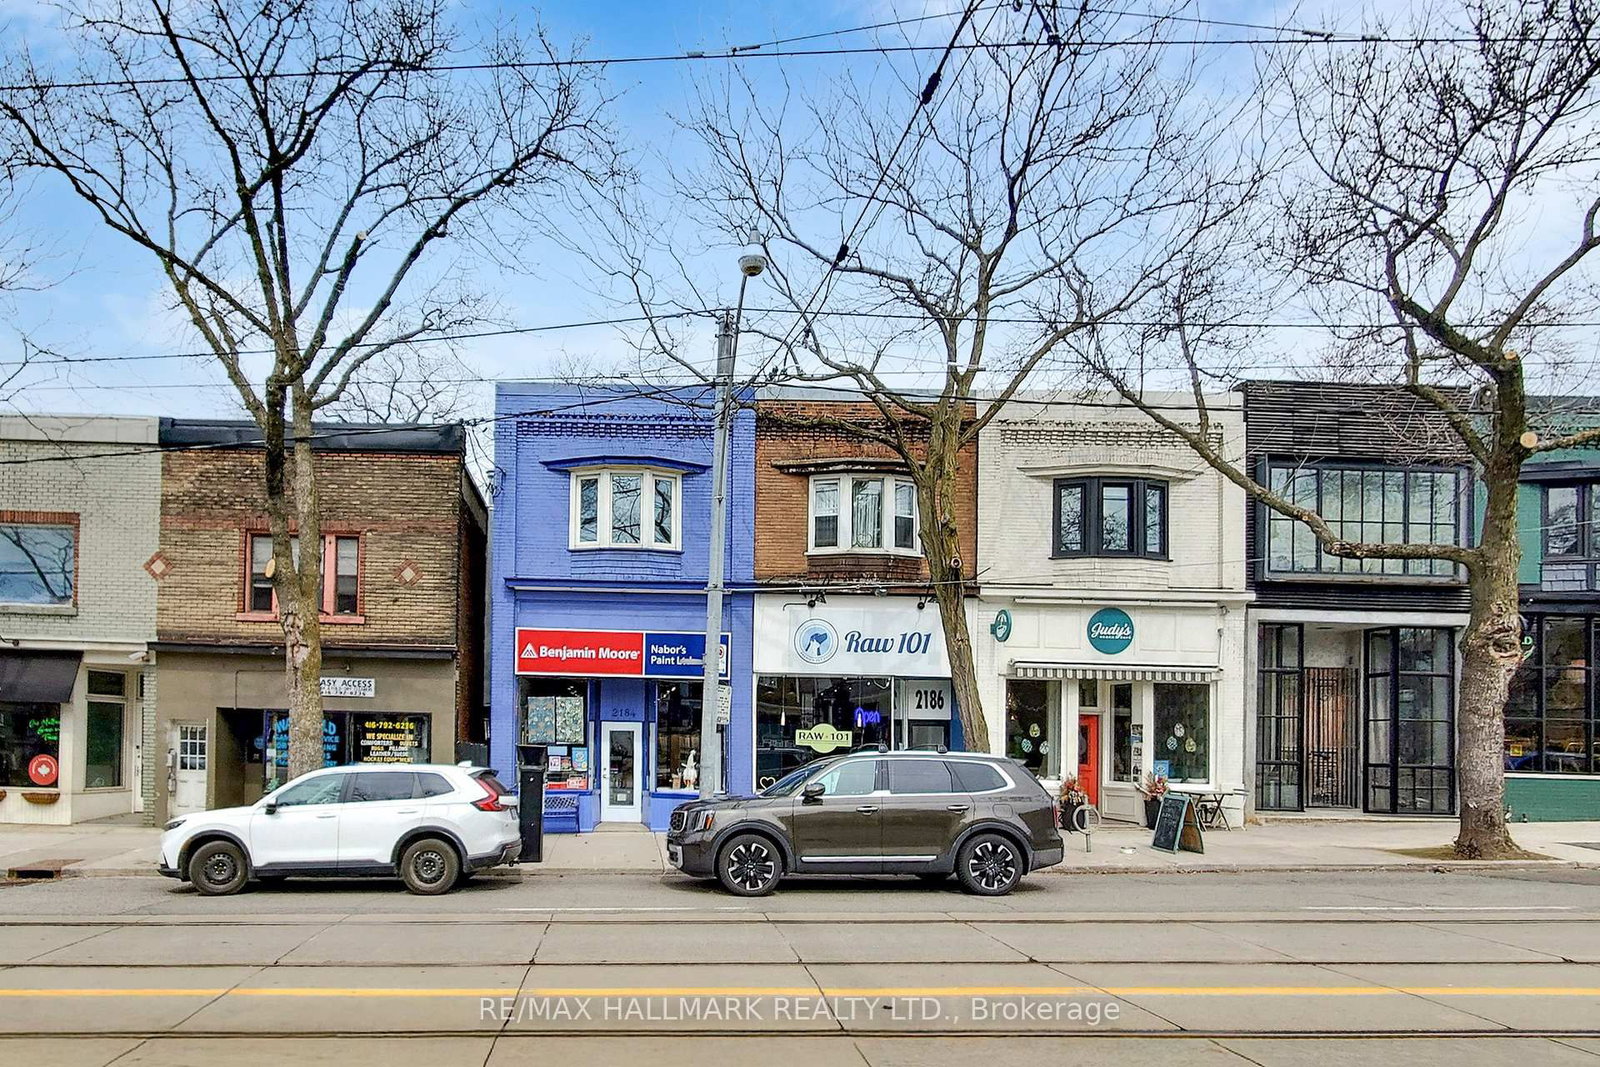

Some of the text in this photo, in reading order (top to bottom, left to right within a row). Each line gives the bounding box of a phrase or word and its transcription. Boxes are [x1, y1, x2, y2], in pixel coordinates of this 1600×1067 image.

[1091, 622, 1131, 639] Judy's
[844, 630, 932, 654] Raw 101
[539, 645, 638, 660] Benjamin Moore
[650, 644, 687, 655] Nabor's
[650, 655, 676, 665] Paint
[341, 679, 372, 687] ACCESS
[915, 689, 945, 710] 2186
[798, 732, 849, 741] RAW 101
